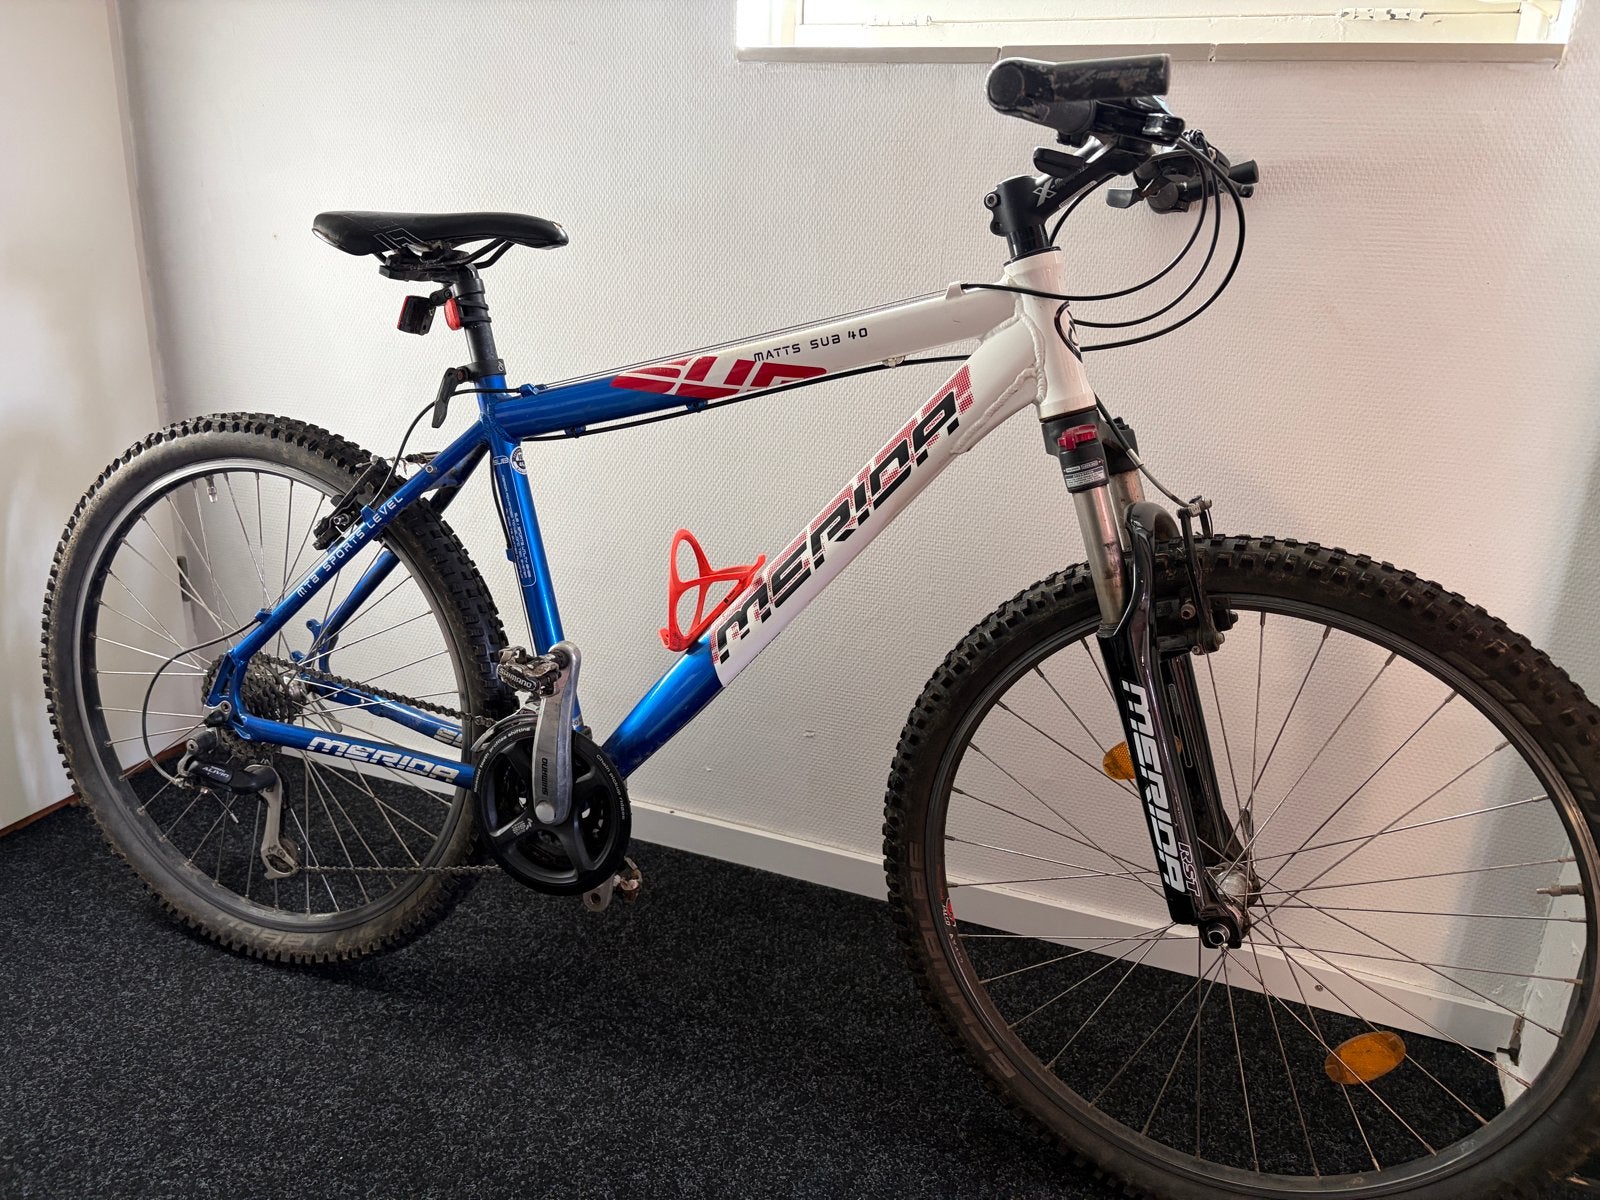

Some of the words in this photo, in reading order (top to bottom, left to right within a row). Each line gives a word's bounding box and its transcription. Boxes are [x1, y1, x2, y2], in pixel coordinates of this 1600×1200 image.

[753, 343, 801, 362] MATTS
[810, 333, 841, 350] SUB
[847, 327, 868, 340] 40
[296, 574, 320, 597] MTB
[322, 529, 366, 572] SPORTS
[366, 496, 404, 529] LEVEL
[716, 390, 960, 665] MERIDA
[499, 667, 532, 688] SHIMANO
[202, 766, 230, 778] ALIVIO
[306, 736, 460, 783] MERIDA
[541, 757, 549, 796] SHIMANO
[1121, 679, 1186, 893] MERIDA
[1178, 841, 1200, 898] RST
